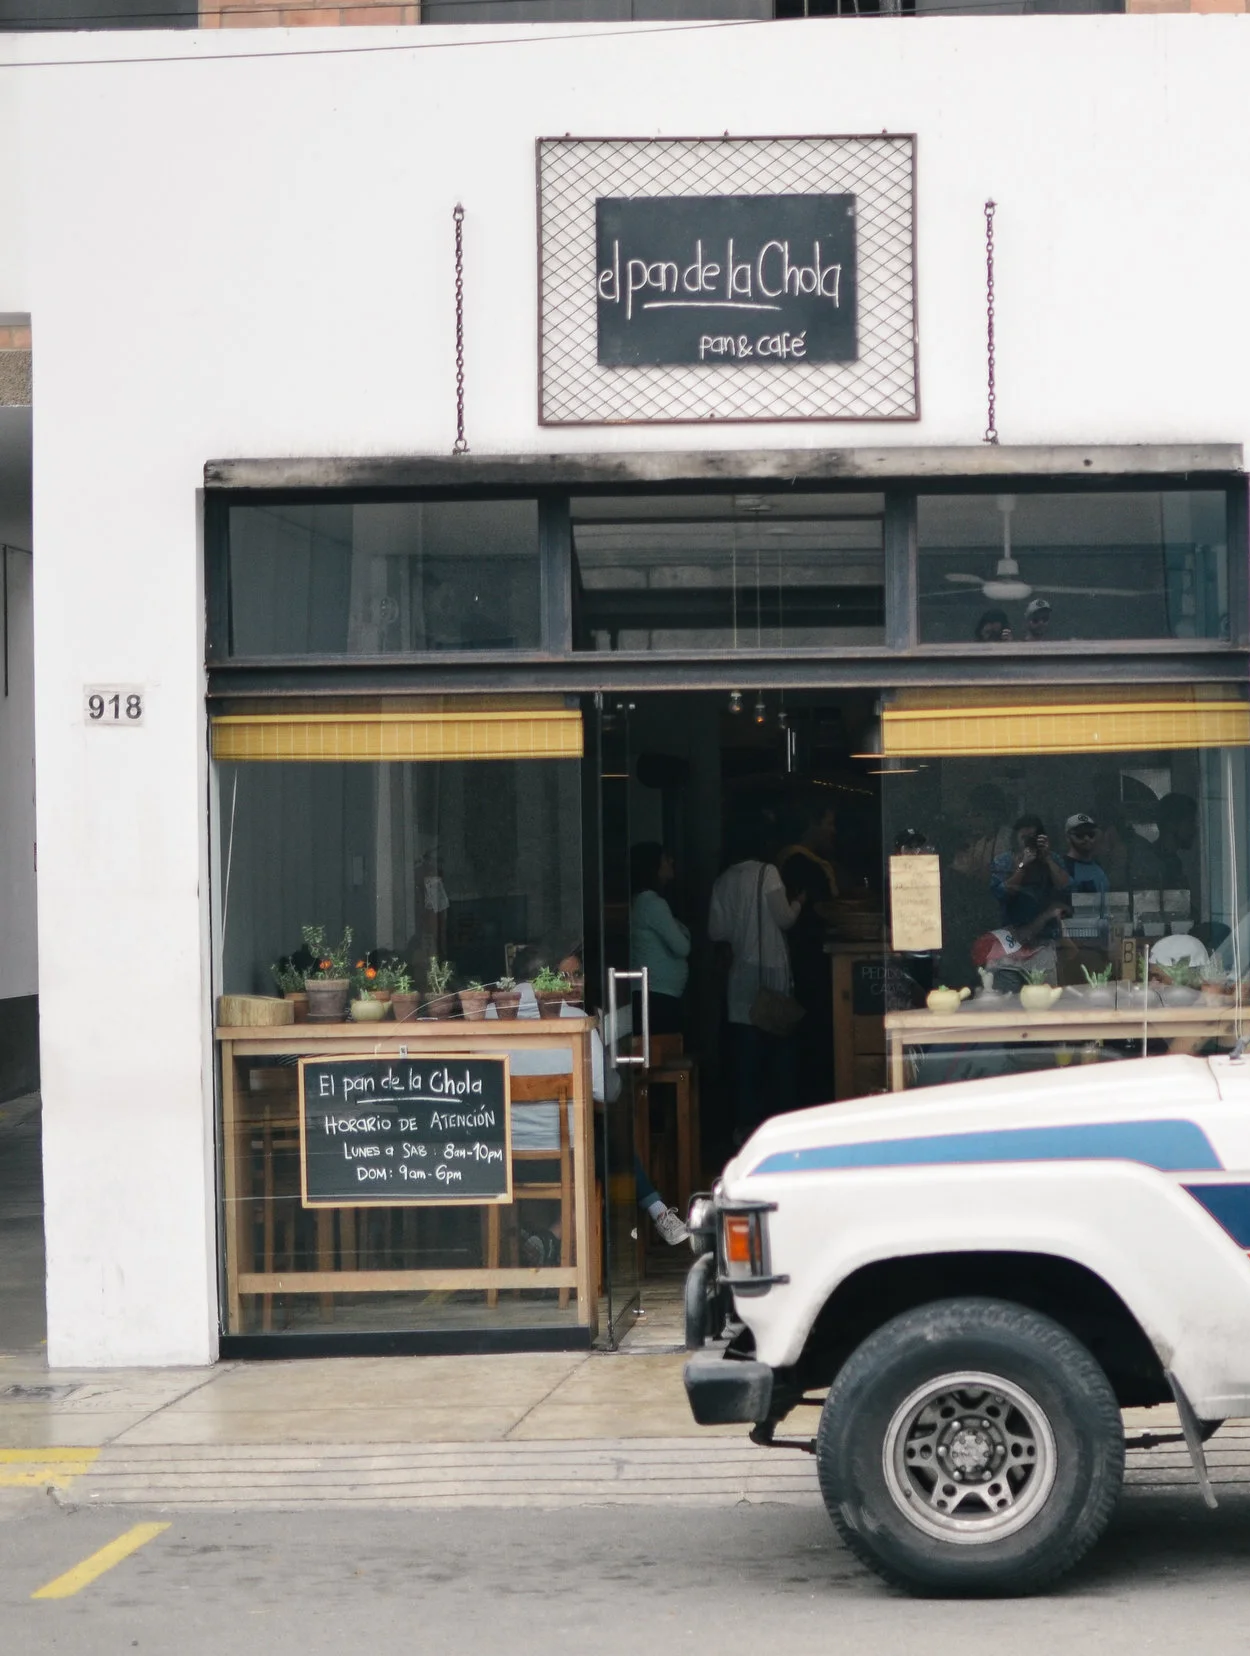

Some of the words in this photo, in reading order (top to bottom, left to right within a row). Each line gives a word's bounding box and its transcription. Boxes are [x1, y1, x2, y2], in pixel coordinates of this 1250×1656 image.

[598, 239, 621, 304] el
[626, 259, 679, 320] pan
[683, 238, 721, 293] de
[726, 238, 752, 300] la
[757, 240, 843, 309] Chola
[88, 694, 142, 720] 918
[319, 1074, 335, 1097] El
[343, 1076, 375, 1102] pan
[381, 1067, 405, 1091] de
[409, 1067, 422, 1092] la
[429, 1067, 482, 1095] Chola
[399, 1117, 418, 1131] DE
[343, 1142, 381, 1160] LUNES
[356, 1166, 393, 1181] DOM:
